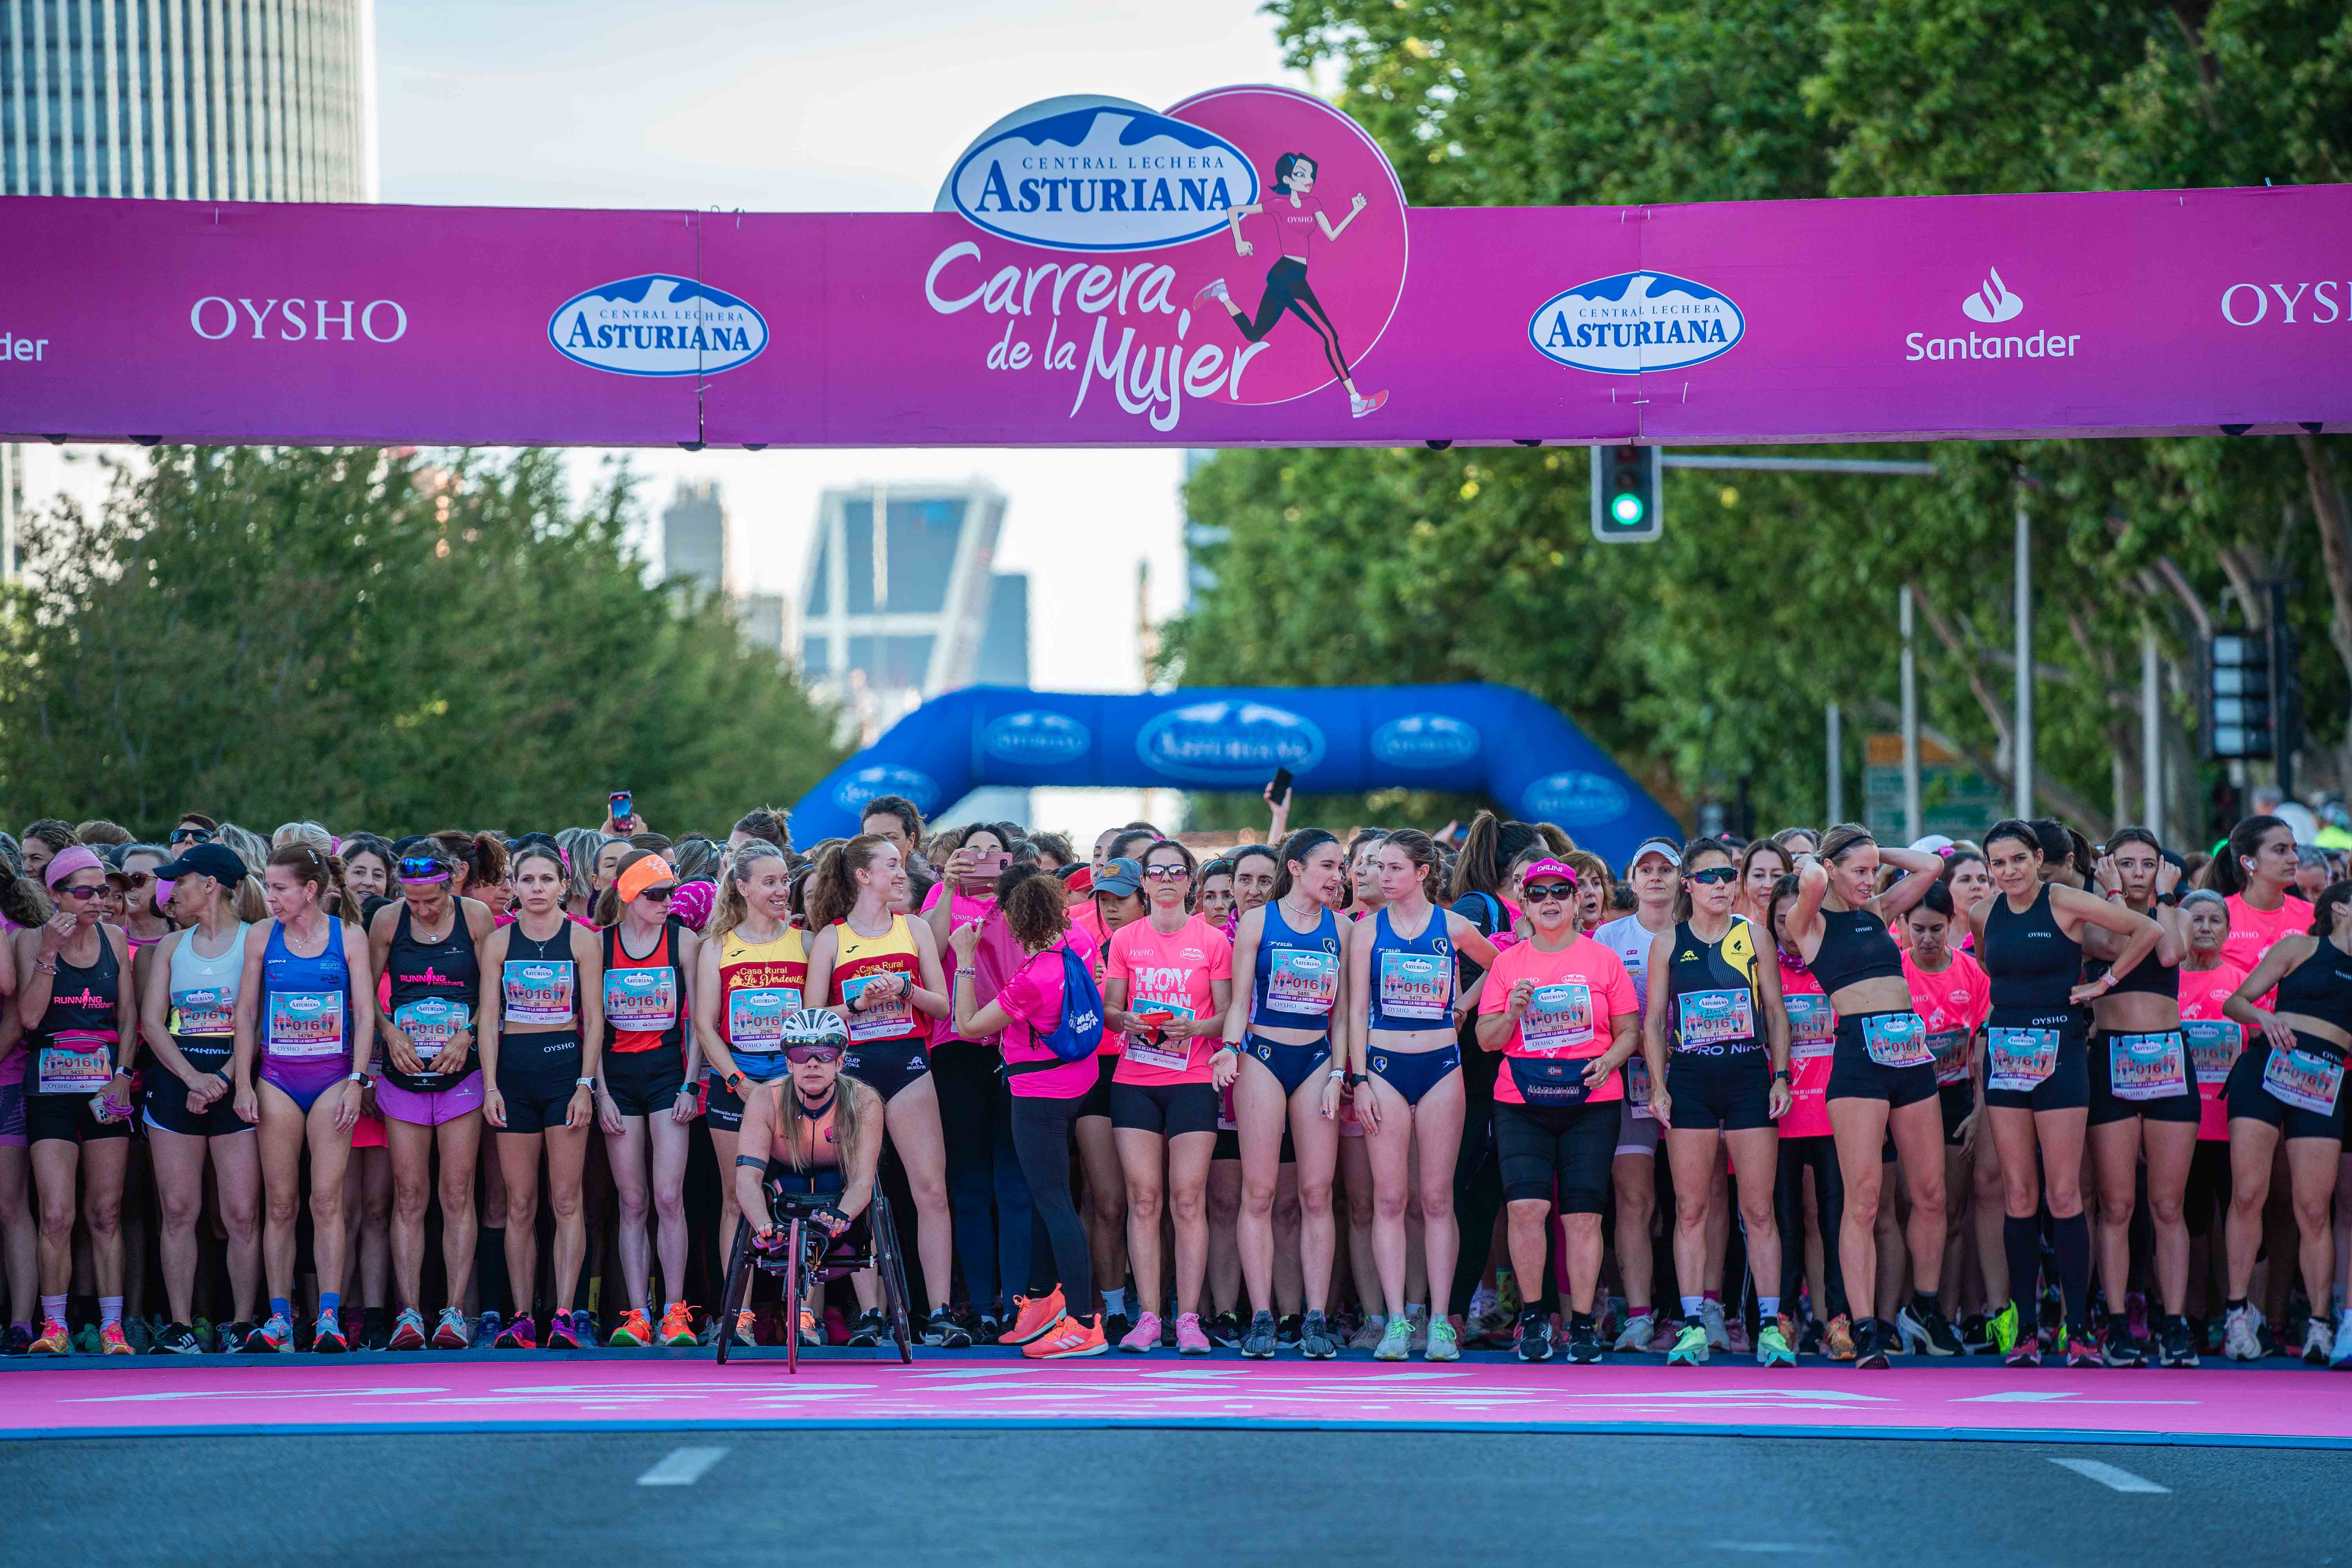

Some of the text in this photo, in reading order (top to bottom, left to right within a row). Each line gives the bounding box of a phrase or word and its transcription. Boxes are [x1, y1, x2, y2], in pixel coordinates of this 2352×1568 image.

[1022, 156, 1224, 170] CENTRAL LECHERA
[975, 159, 1232, 213] ASTURIANA
[926, 242, 1176, 315] Carrera
[2221, 281, 2352, 326] OYS
[599, 310, 744, 321] CENTRAL LECHERA
[1579, 305, 1720, 318] CENTRAL LECHERA
[191, 297, 407, 342] OYSHO
[566, 311, 752, 351] ASTURIANA
[1546, 310, 1728, 348] ASTURIANA
[1906, 330, 2080, 361] Santander
[987, 309, 1270, 432] de la Mujer
[952, 913, 974, 921] Sports
[860, 960, 903, 973] Casa Rural
[1135, 967, 1192, 992] HOY
[1293, 978, 1319, 990] 016
[1404, 982, 1430, 993] 016
[525, 989, 551, 999] 016
[1540, 993, 1566, 1001] ASTURIANA
[627, 996, 653, 1006] 016
[869, 1001, 895, 1014] 016
[192, 1011, 218, 1020] 016
[1544, 1011, 1570, 1024] 016
[2032, 1015, 2067, 1025] OYSHO
[293, 1020, 320, 1031] 016
[753, 1016, 780, 1027] 016
[1703, 1019, 1730, 1029] 016
[419, 1024, 445, 1034] 016
[544, 1042, 575, 1053] OYSHO
[1891, 1040, 1912, 1053] 016
[2190, 1047, 2217, 1058] 016
[65, 1057, 91, 1067] 016
[1158, 1058, 1179, 1066] Santander
[2007, 1055, 2032, 1066] 016
[2136, 1063, 2161, 1074] 016
[2290, 1068, 2317, 1085] 016
[711, 1108, 731, 1116] Federación
